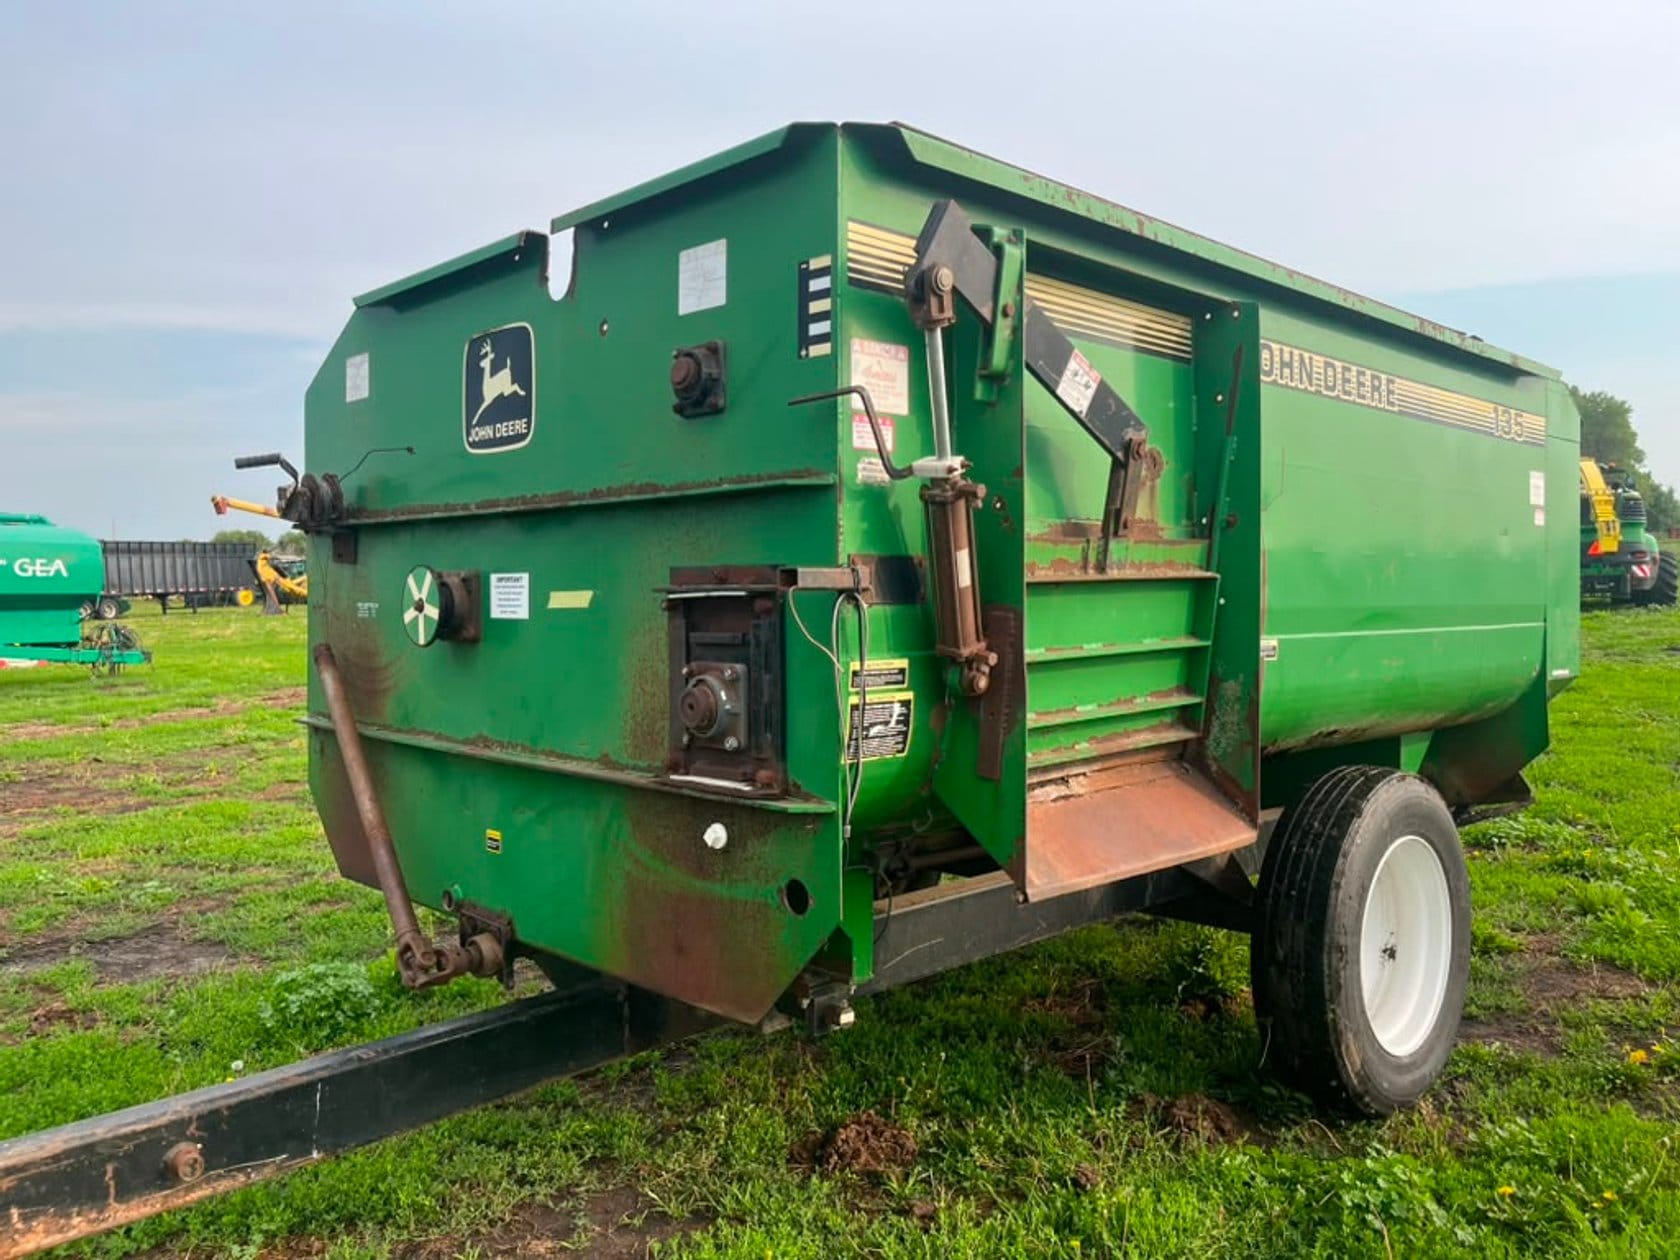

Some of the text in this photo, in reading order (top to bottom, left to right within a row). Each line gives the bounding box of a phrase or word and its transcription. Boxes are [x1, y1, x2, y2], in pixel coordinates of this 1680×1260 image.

[1260, 341, 1398, 409] OHN DEERE
[468, 418, 528, 442] JOHN DEERE
[1493, 406, 1525, 439] 135
[13, 558, 69, 577] GEA
